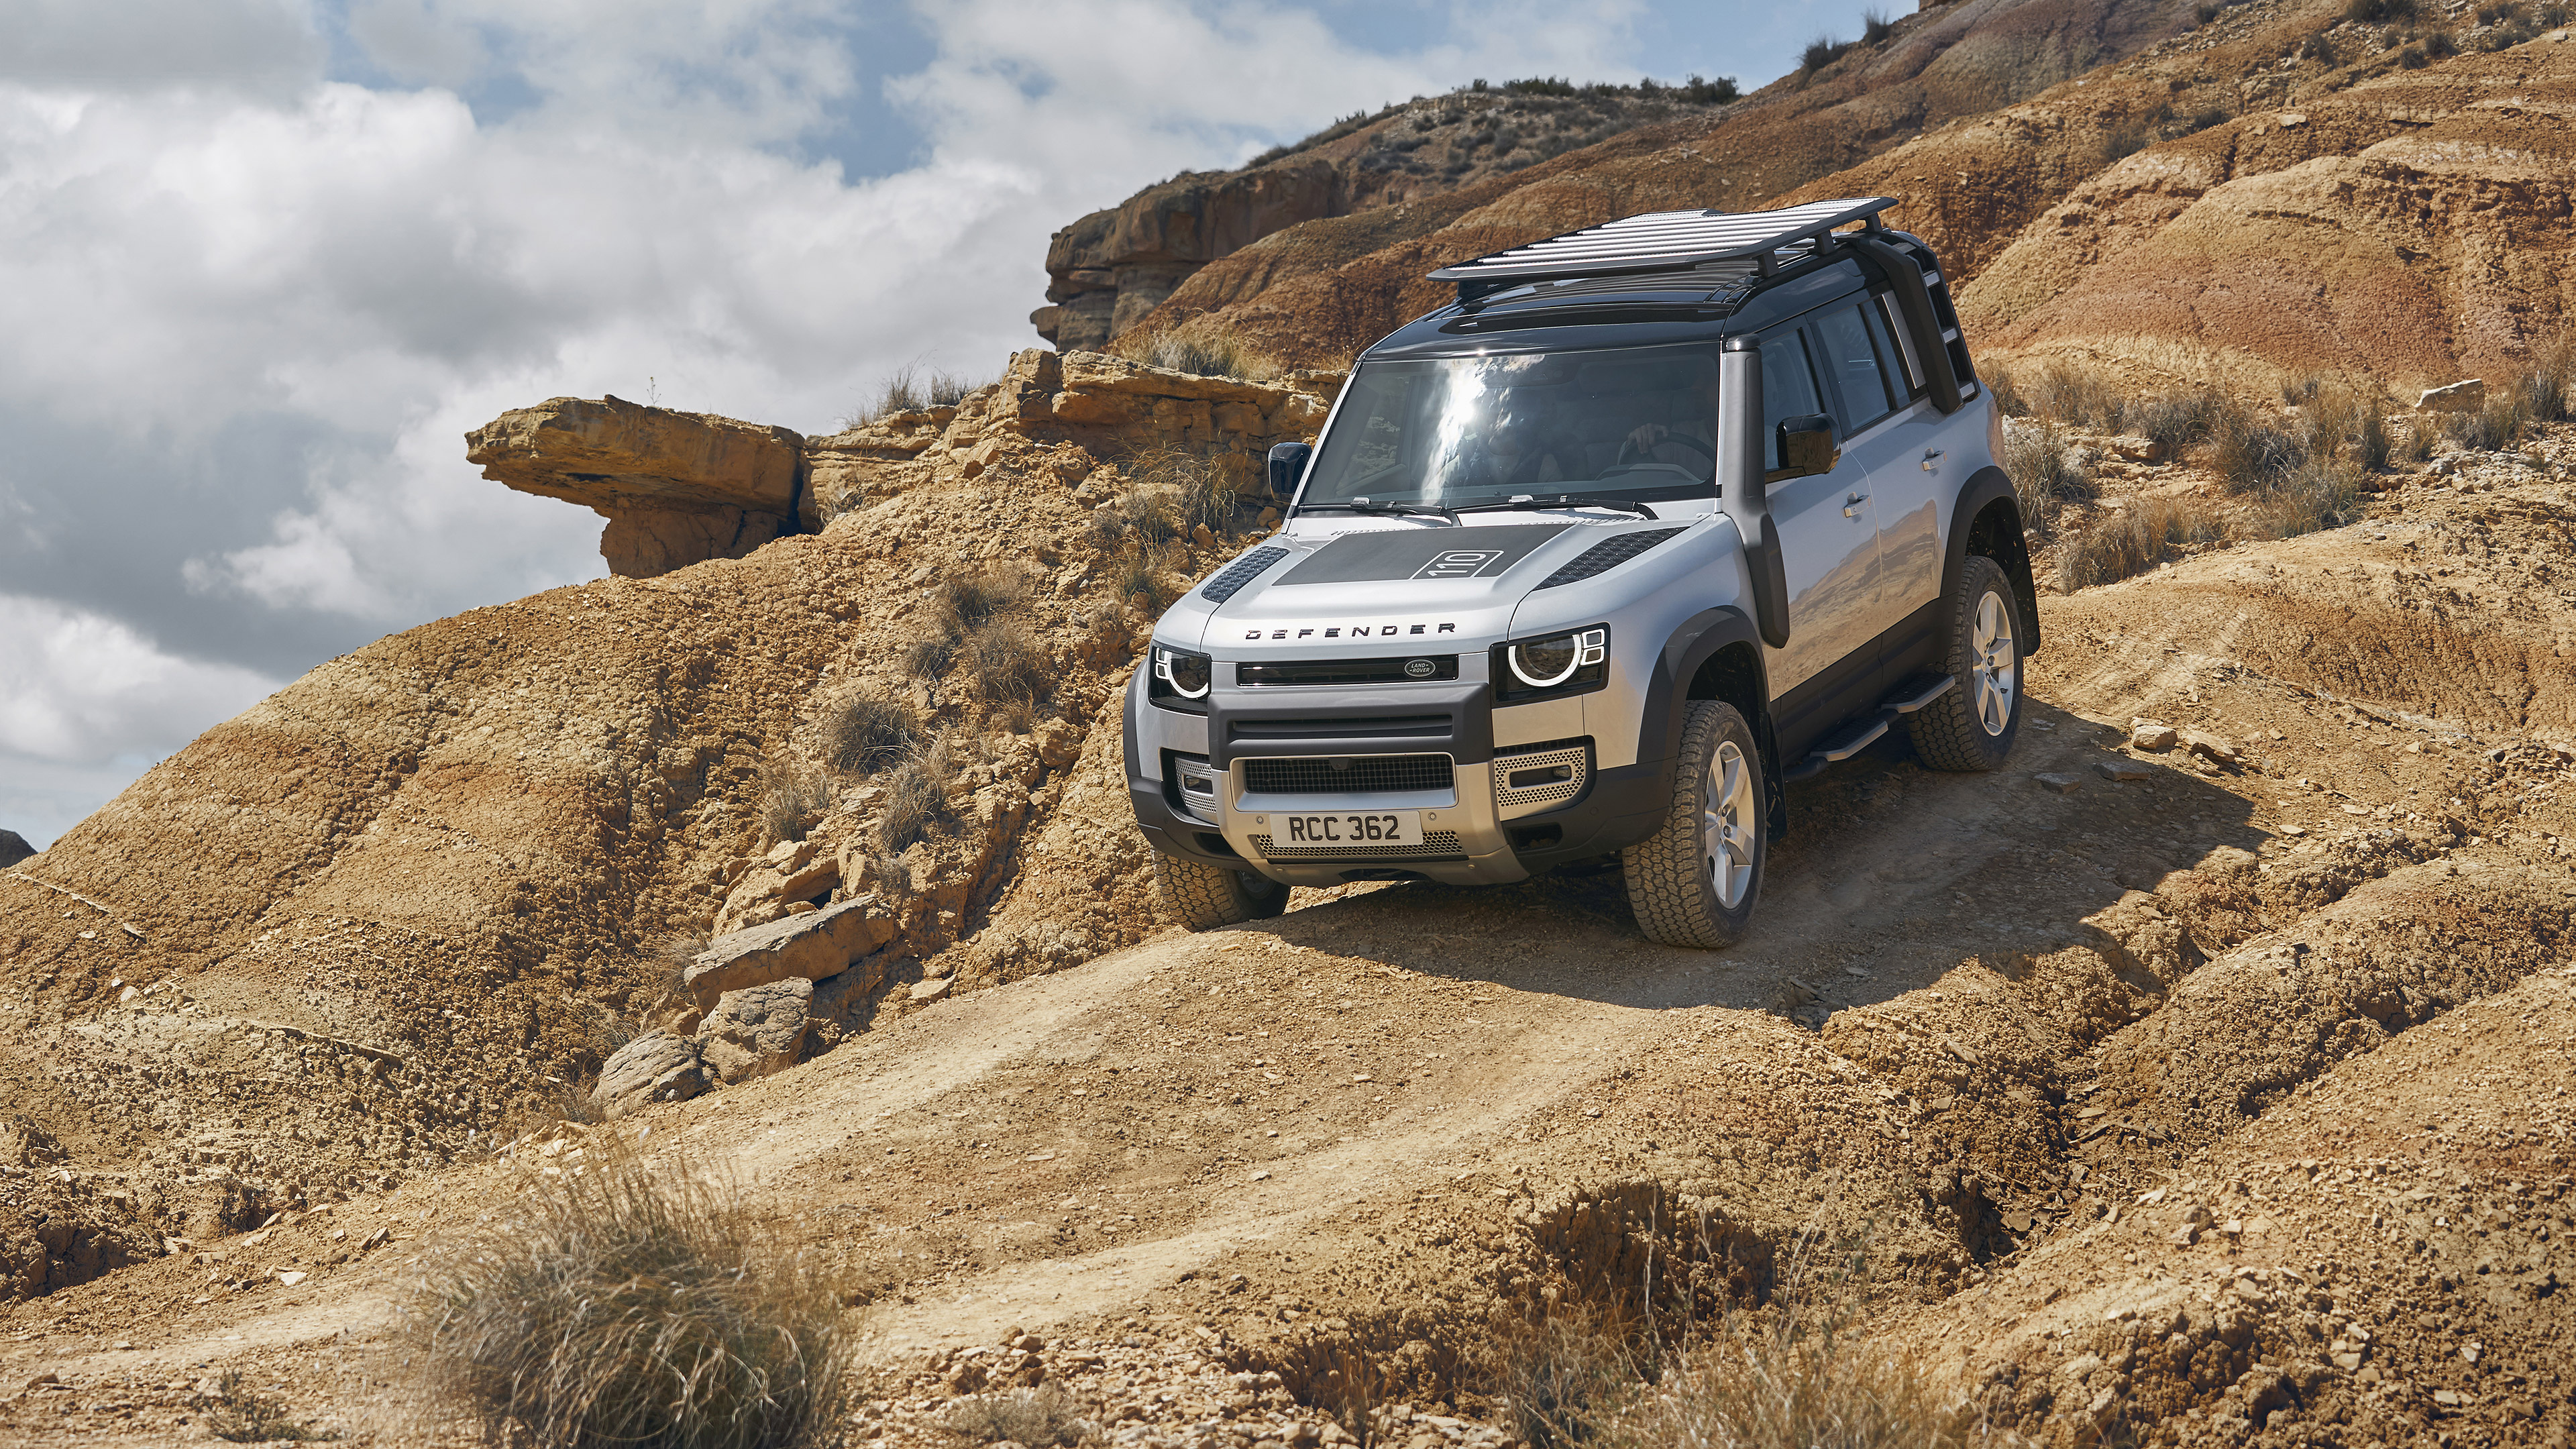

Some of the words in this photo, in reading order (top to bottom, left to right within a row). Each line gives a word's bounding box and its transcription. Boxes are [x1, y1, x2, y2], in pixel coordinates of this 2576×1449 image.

[1427, 553, 1487, 576] 110
[1246, 623, 1456, 640] DEFENDER
[1289, 816, 1340, 841] RCC
[1347, 815, 1401, 841] 362
